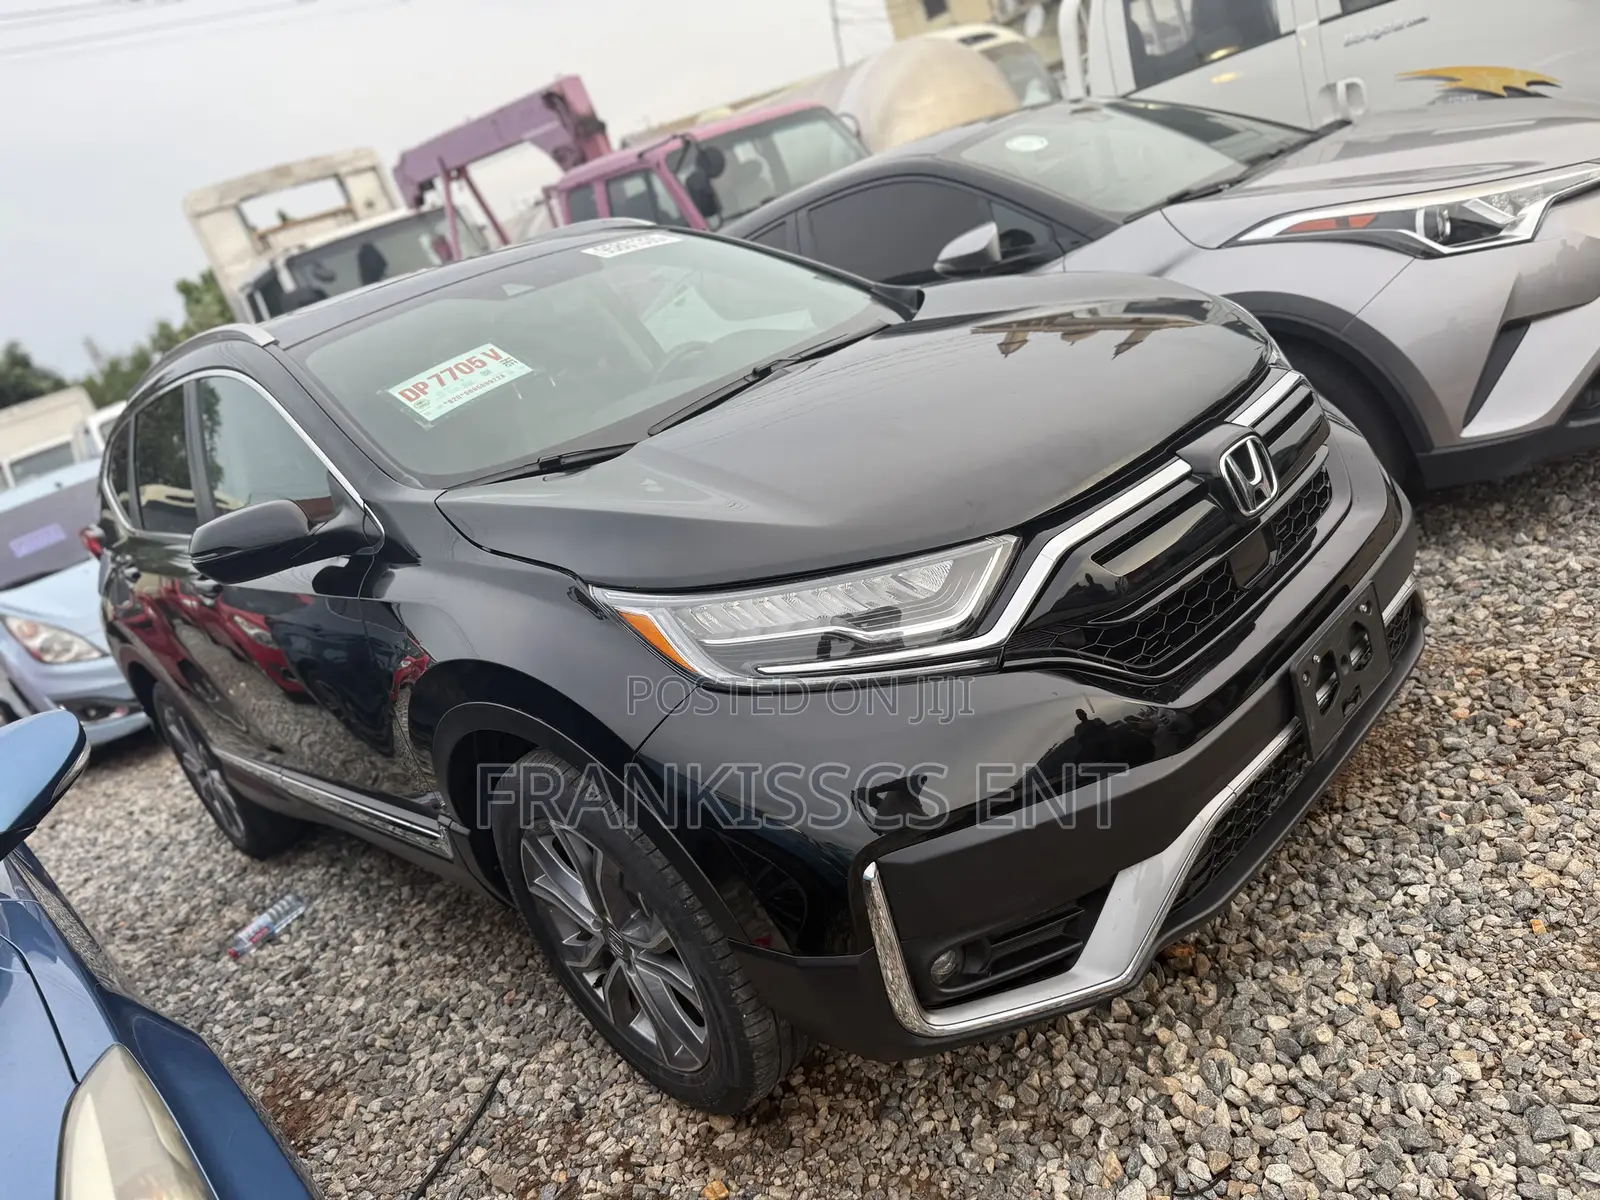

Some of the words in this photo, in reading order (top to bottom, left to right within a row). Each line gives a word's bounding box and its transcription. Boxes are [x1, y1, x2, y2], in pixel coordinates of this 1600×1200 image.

[398, 381, 429, 402] DP
[426, 356, 487, 387] 7705
[481, 348, 503, 361] V
